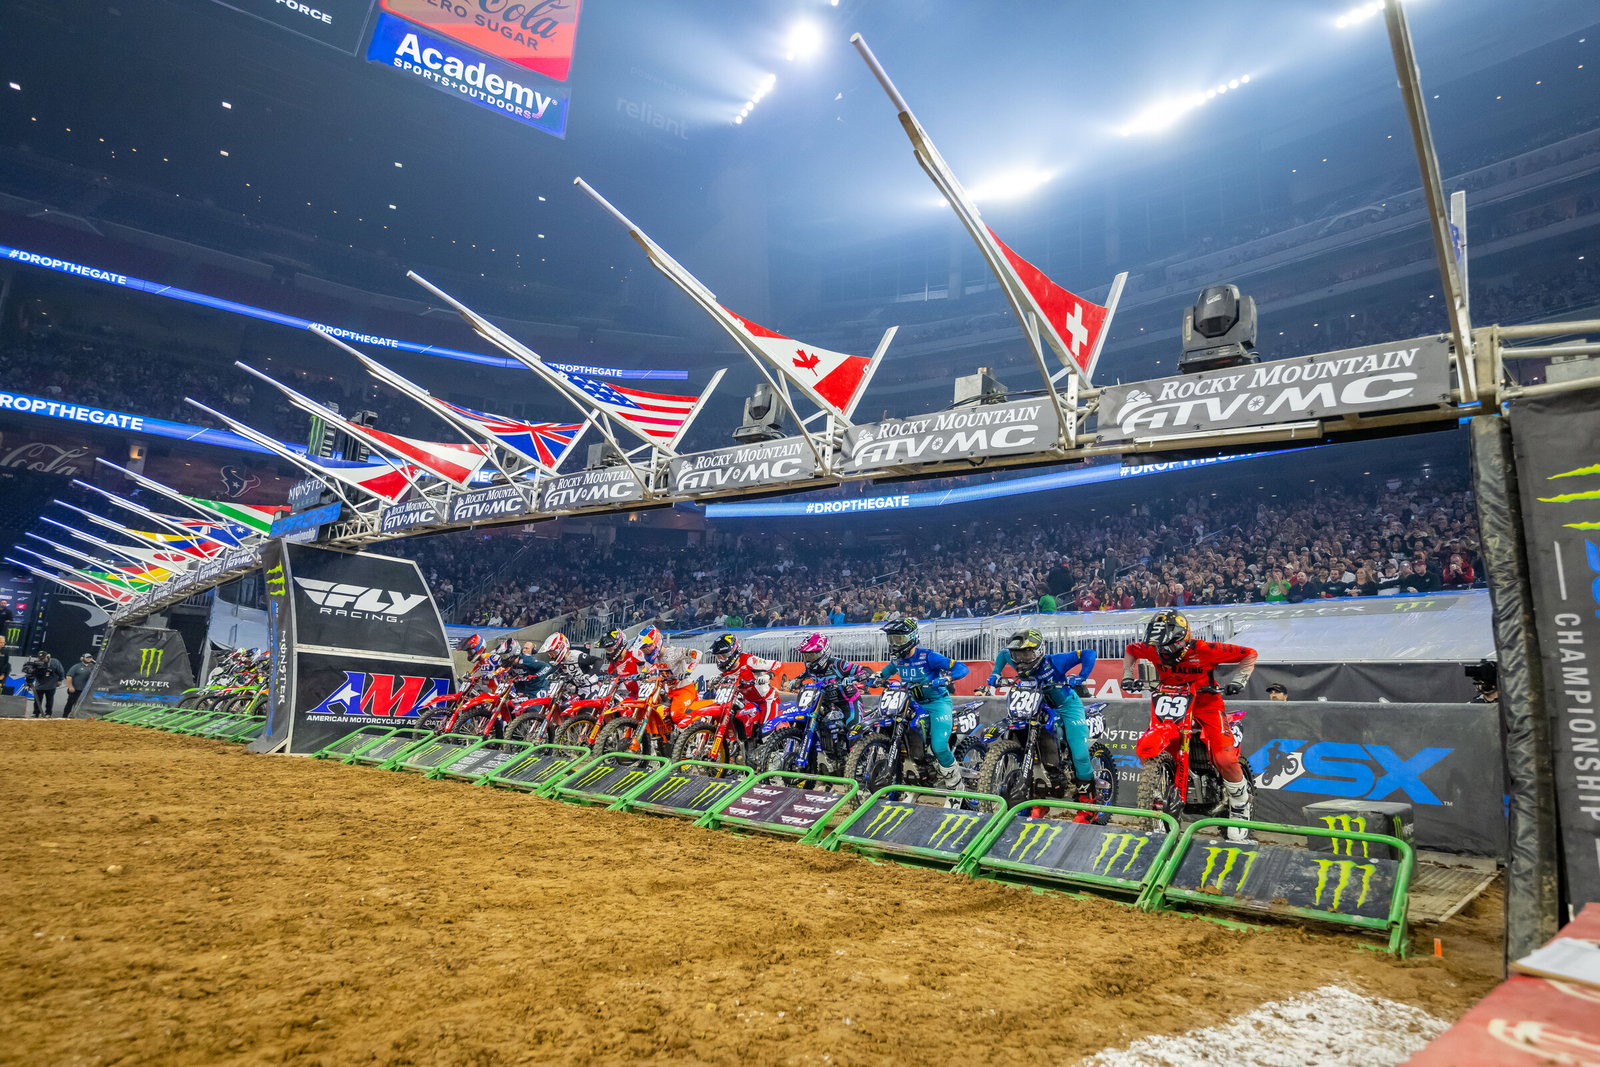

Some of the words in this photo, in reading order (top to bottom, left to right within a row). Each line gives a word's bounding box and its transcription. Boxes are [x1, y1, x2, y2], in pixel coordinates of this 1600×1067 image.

[275, 0, 333, 24] ORCE
[474, 14, 539, 51] SUGAR
[393, 57, 532, 119] SPORTS+OUTDOORS
[395, 33, 552, 119] Academy
[616, 97, 688, 141] reliant
[8, 249, 127, 285] #DROPTHEGATE
[1160, 374, 1246, 402] ROCKY
[1247, 347, 1420, 389] MOUNTAIN
[1118, 392, 1252, 435] ATV
[1263, 372, 1418, 415] MC
[878, 416, 937, 440] ROCKY
[937, 405, 1041, 429] MOUNTAIN
[694, 452, 734, 469] ROCKY
[734, 442, 805, 464] MOUNTAIN
[852, 434, 934, 467] ATV
[941, 424, 1040, 454] MC
[557, 476, 583, 490] ROCKY
[677, 460, 735, 492] ATV
[739, 458, 803, 482] MC
[464, 493, 487, 505] ROCKY
[545, 487, 583, 509] ATV
[585, 482, 635, 501] MC
[805, 494, 910, 515] #DROPTHEGATE
[308, 579, 429, 615] FLY
[319, 607, 399, 623] RACING
[278, 630, 288, 705] MONSTER
[119, 679, 170, 689] MONSTER
[306, 671, 450, 717] AMA
[798, 690, 814, 707] 6
[881, 690, 906, 710] 58
[1010, 690, 1041, 712] 238
[1155, 696, 1188, 717] 63
[306, 715, 349, 723] AMERICAN
[349, 716, 405, 725] MOTORCYCLIST
[959, 712, 977, 733] 58
[1087, 714, 1105, 738] 238
[1553, 612, 1600, 822] CHAMPIONSHIP
[888, 741, 897, 768] DUNLOP
[1023, 749, 1032, 779] DUNLOP
